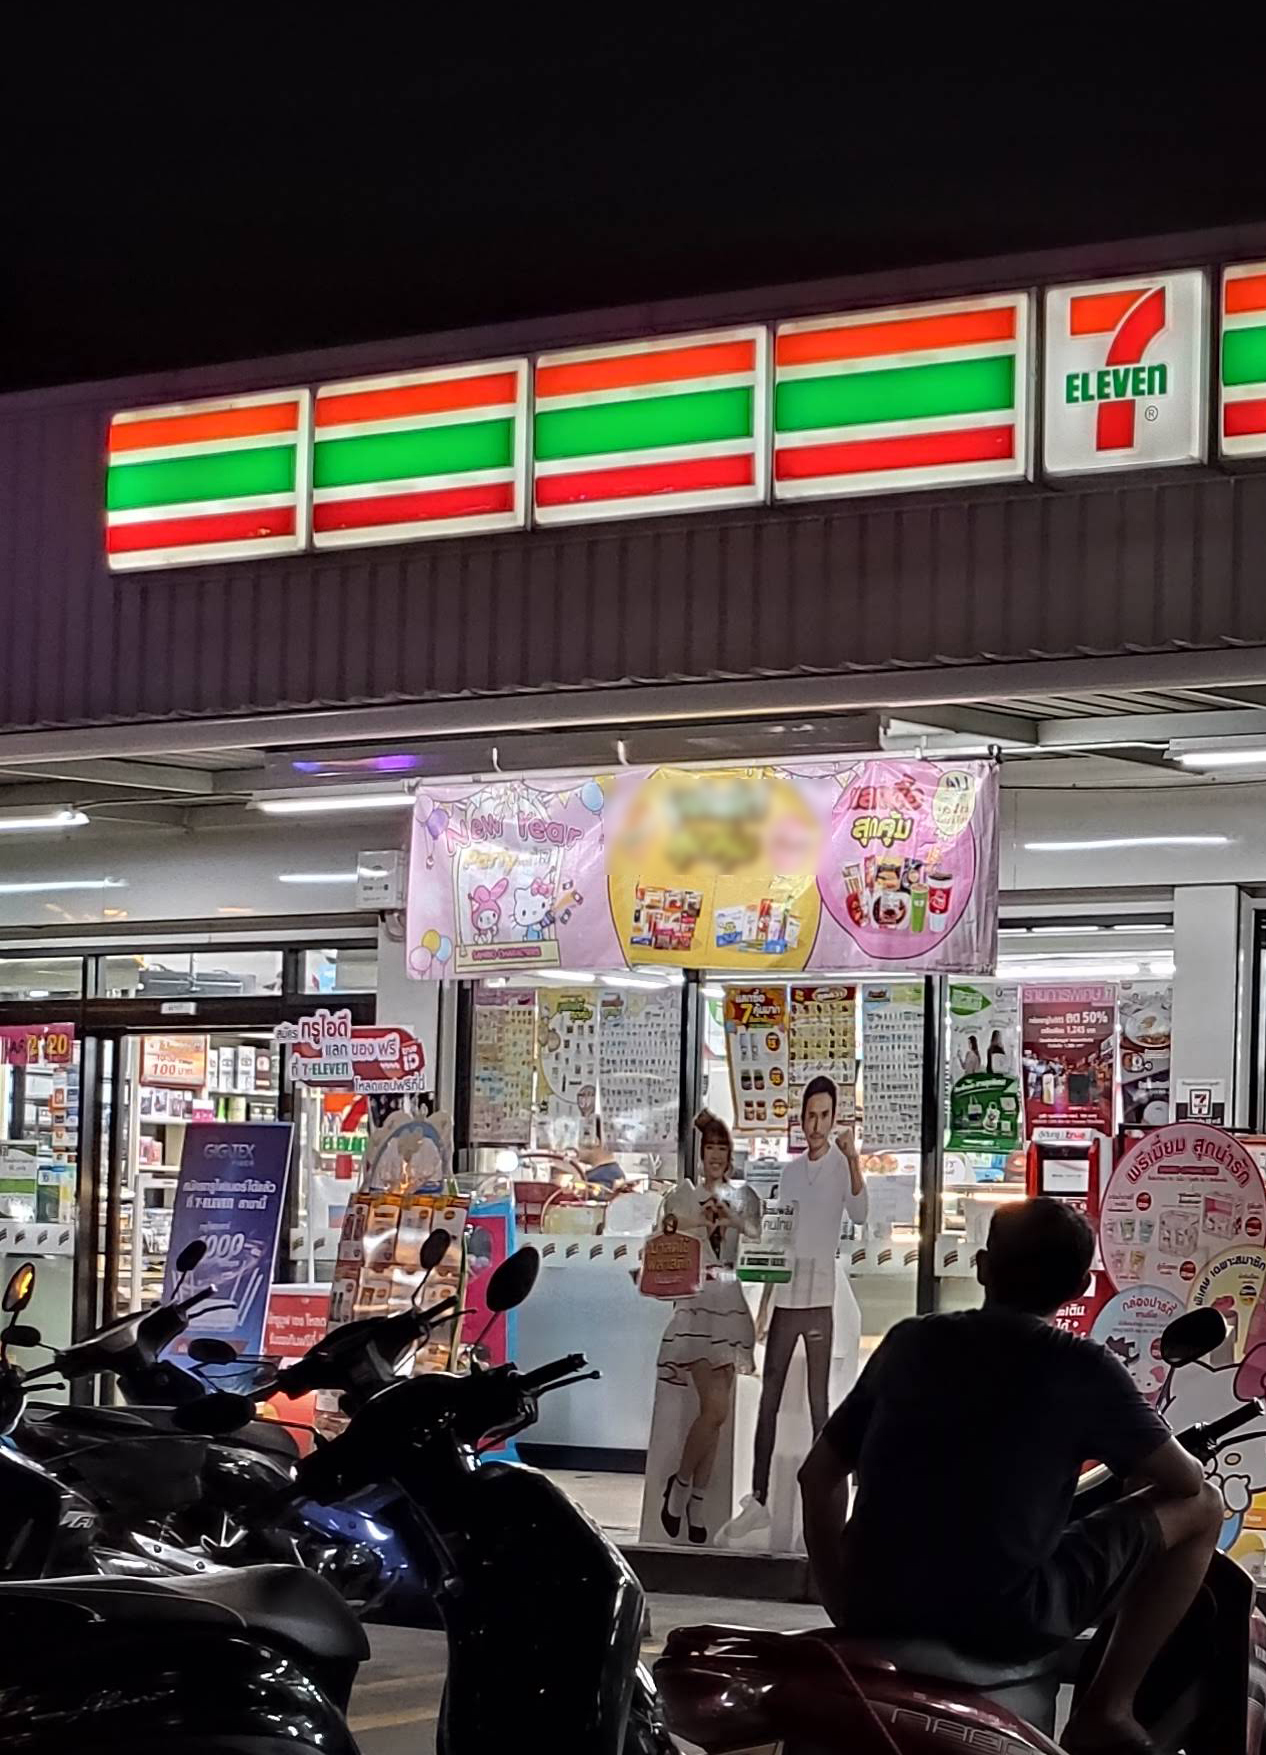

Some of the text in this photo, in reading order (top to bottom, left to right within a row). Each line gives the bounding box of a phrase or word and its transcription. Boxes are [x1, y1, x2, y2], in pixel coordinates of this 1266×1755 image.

[1070, 287, 1166, 451] 7
[445, 812, 583, 856] New Year
[301, 1014, 348, 1045] ทรูไอดี
[1082, 1011, 1108, 1024] 50%
[325, 1037, 396, 1056] แลก ของ ฟรี
[152, 1063, 177, 1076] 100
[1126, 1133, 1186, 1185] พรีเมี่ยม
